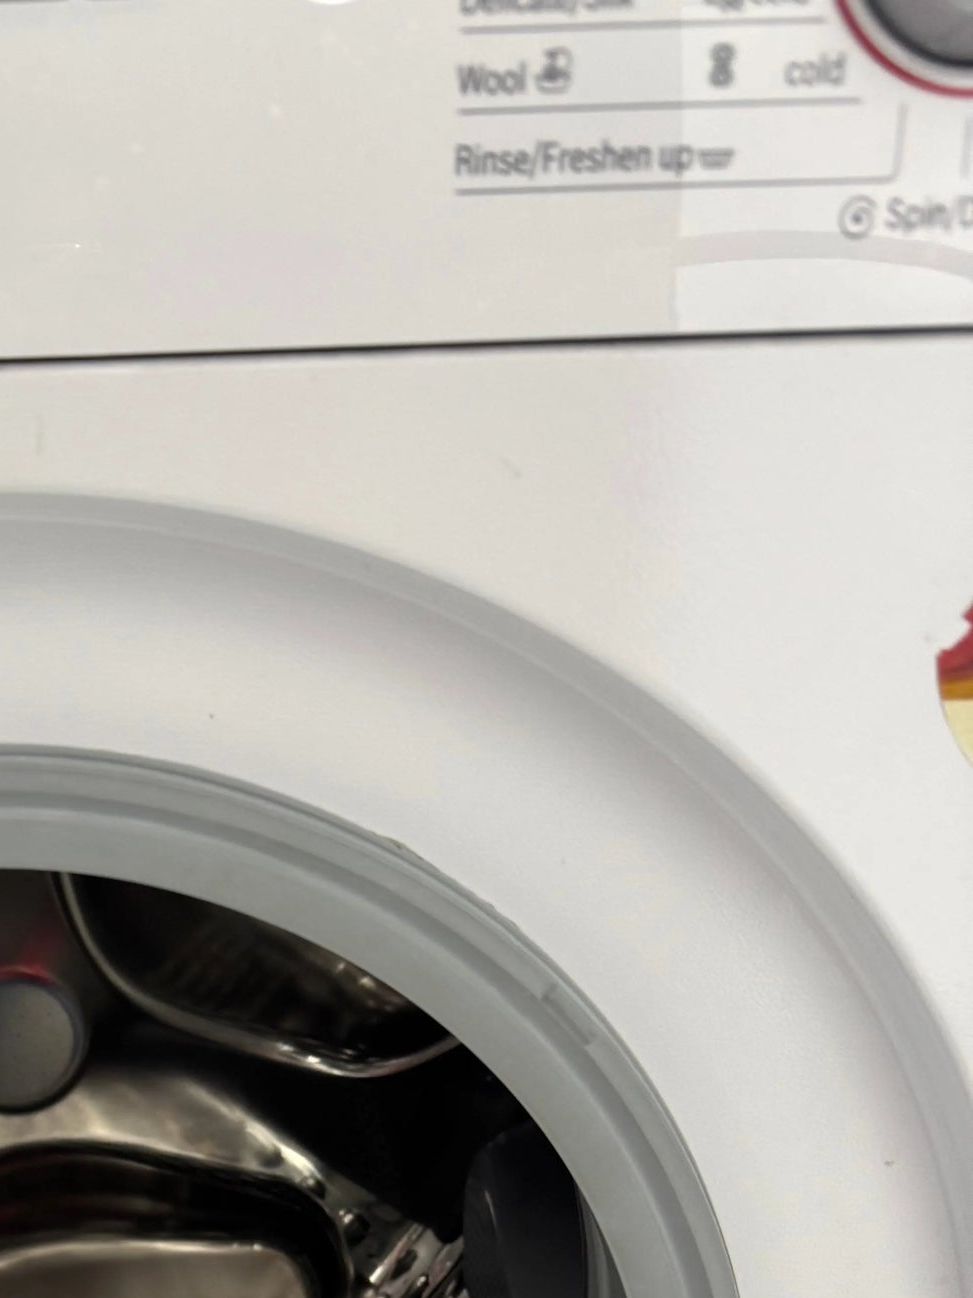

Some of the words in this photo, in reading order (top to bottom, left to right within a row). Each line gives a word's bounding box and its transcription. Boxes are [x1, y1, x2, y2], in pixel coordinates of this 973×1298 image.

[456, 62, 525, 95] Wool
[785, 51, 845, 87] cold
[454, 139, 652, 179] Rinse/Freshen
[658, 144, 693, 180] up
